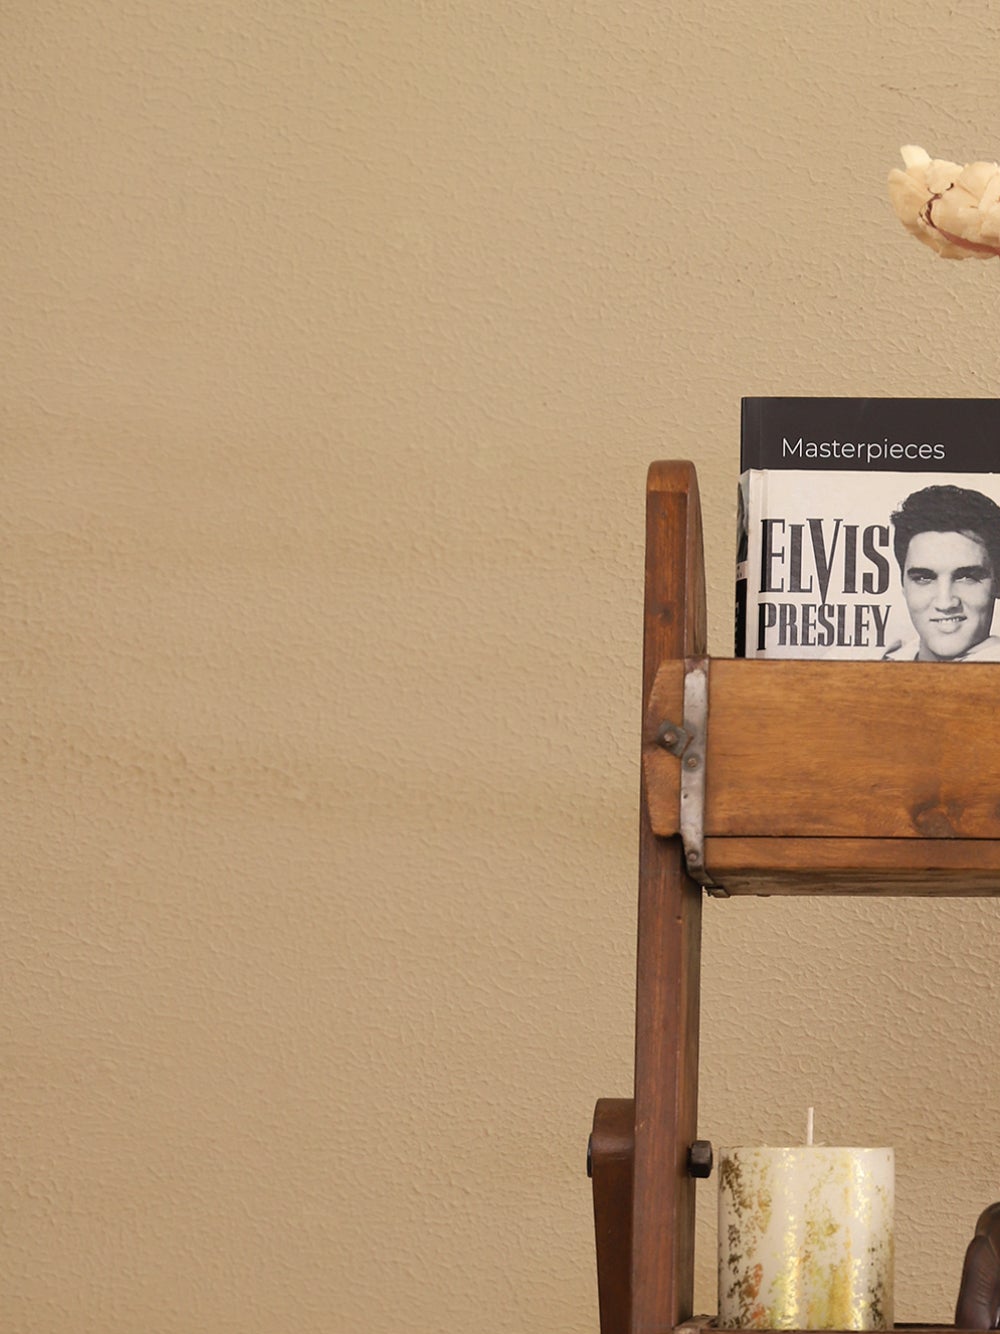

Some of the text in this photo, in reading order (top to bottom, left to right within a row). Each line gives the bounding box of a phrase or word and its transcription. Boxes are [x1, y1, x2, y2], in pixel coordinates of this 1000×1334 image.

[782, 437, 946, 464] Masterpieces
[758, 518, 890, 605] ELVIS
[756, 602, 892, 651] PRESLEY
